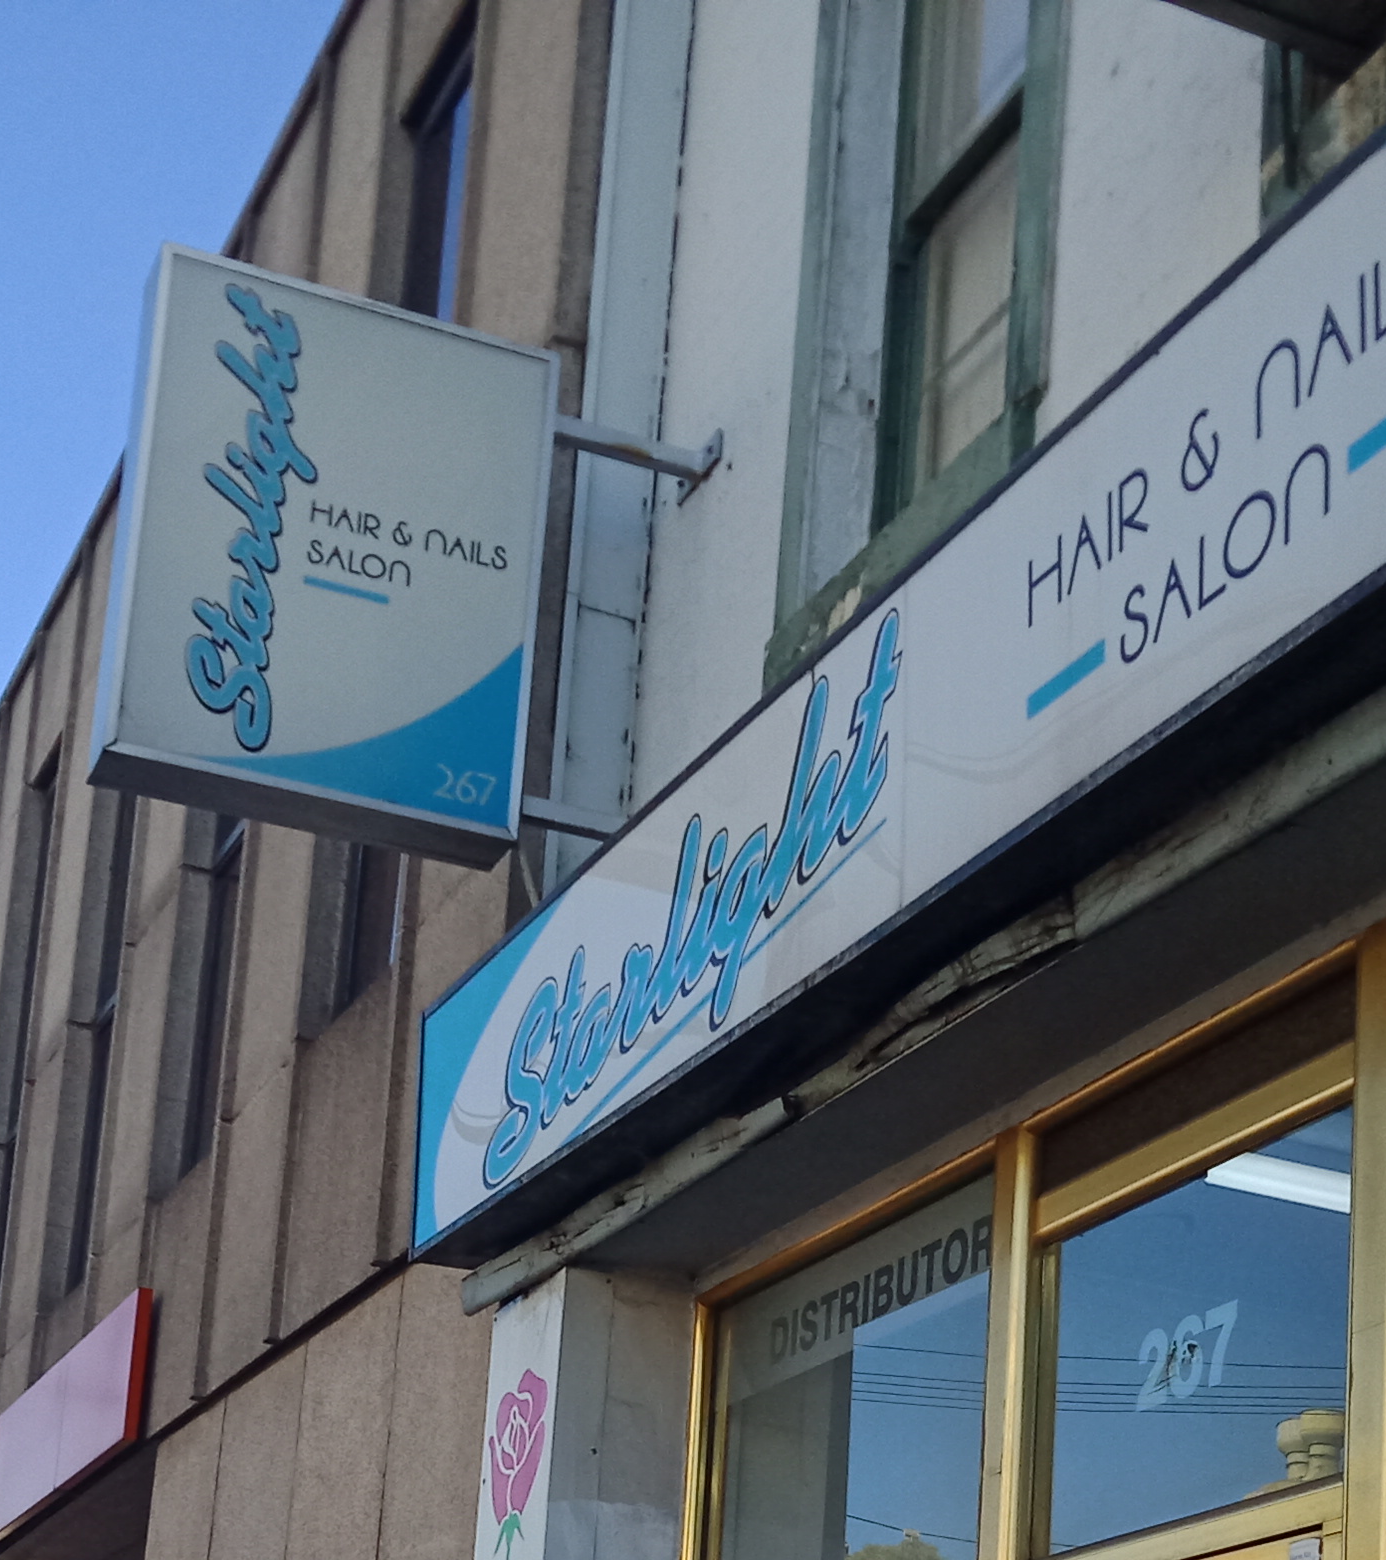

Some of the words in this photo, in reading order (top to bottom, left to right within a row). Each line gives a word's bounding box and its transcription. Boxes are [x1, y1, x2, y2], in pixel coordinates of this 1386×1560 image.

[185, 283, 317, 752] Starlight
[306, 539, 411, 587] SALON
[311, 500, 379, 538] HAIR
[393, 521, 412, 548] &
[425, 528, 509, 571] NAILS
[1028, 469, 1149, 628] HAIR
[1181, 408, 1219, 492] &
[1120, 443, 1331, 664] SALON
[434, 766, 496, 806] 267
[483, 607, 904, 1189] Starlight
[769, 1214, 993, 1365] DISTRIBUTOR
[1136, 1299, 1238, 1412] 267
